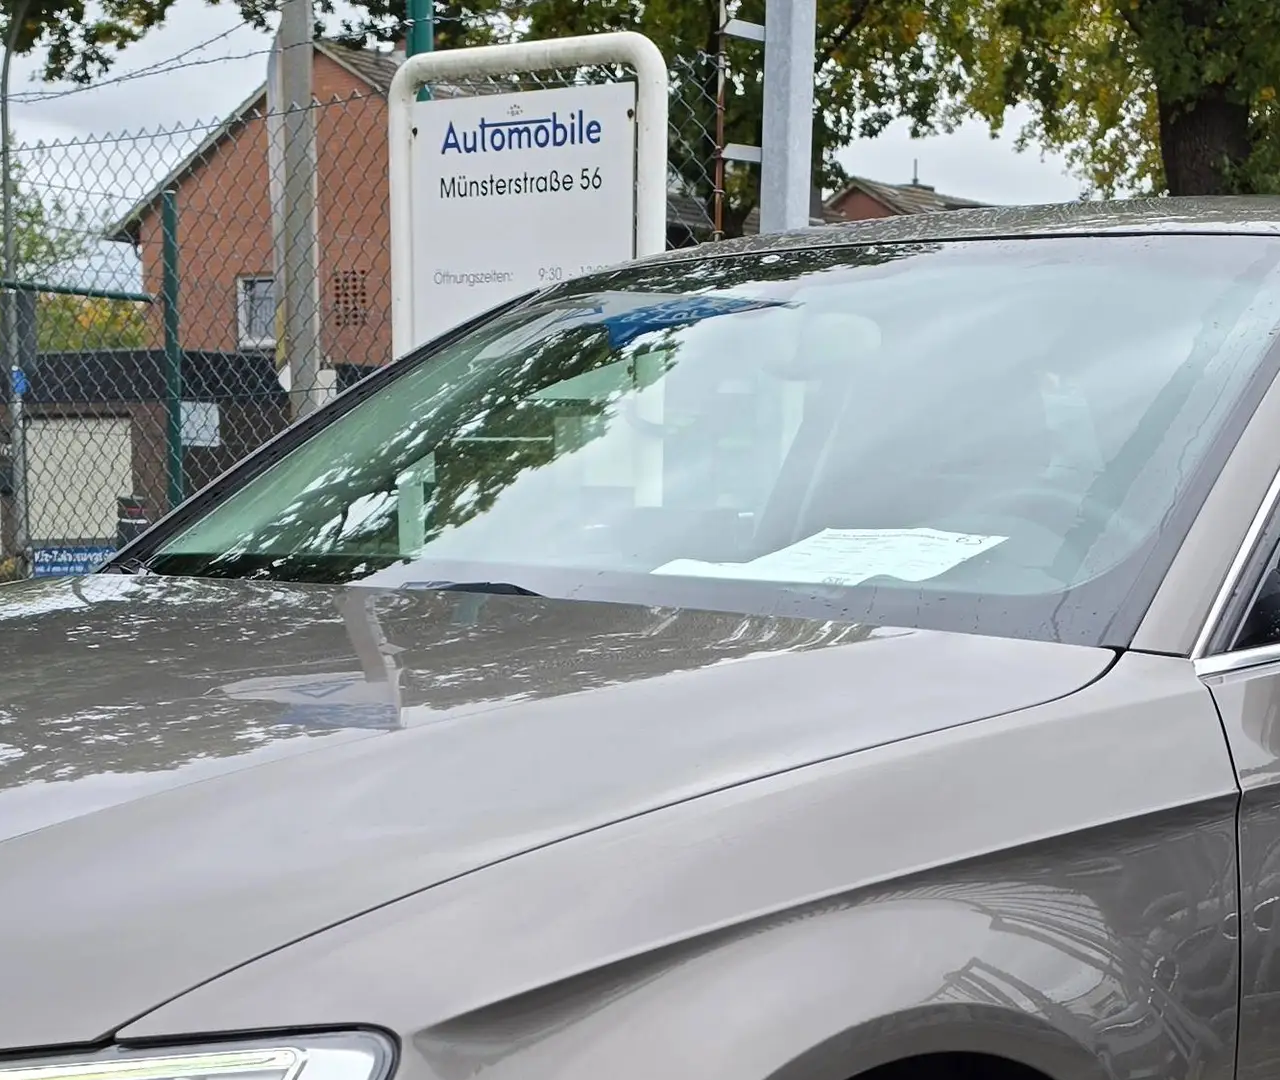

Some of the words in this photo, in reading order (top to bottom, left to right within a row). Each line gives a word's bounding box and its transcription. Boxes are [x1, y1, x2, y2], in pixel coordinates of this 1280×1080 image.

[441, 109, 601, 155] Automobile
[440, 170, 574, 199] Münsterstraße
[579, 166, 602, 191] 56
[538, 267, 563, 282] 9:30
